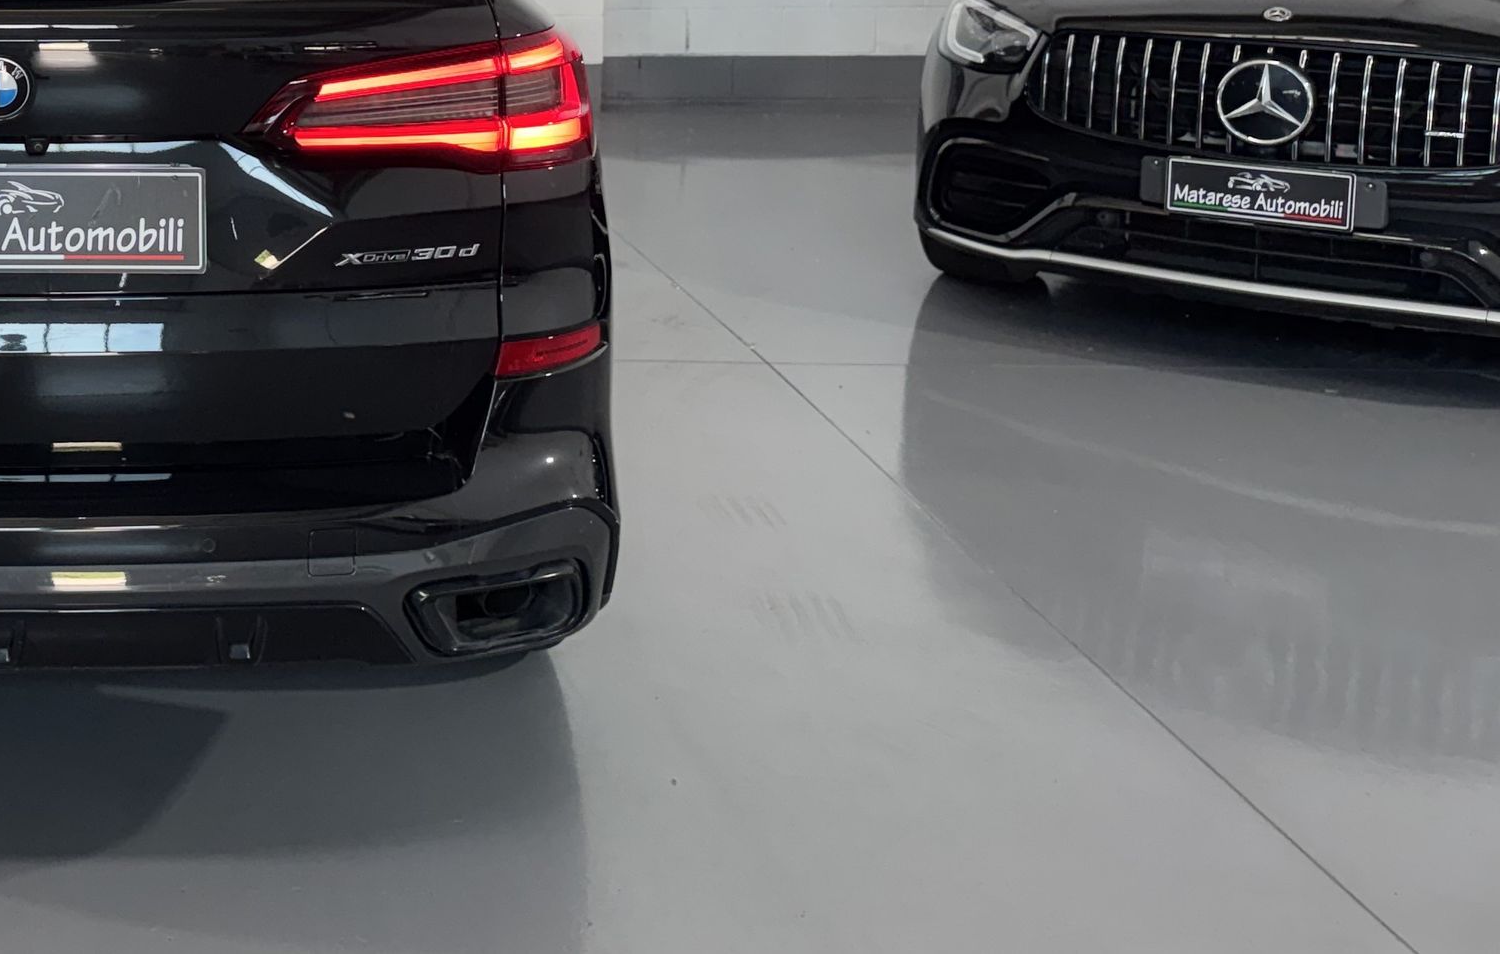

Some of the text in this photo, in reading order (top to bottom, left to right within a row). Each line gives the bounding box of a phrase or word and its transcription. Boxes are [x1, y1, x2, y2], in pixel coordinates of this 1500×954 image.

[1174, 183, 1344, 219] Matarese Automobili
[1, 216, 185, 252] Automobili
